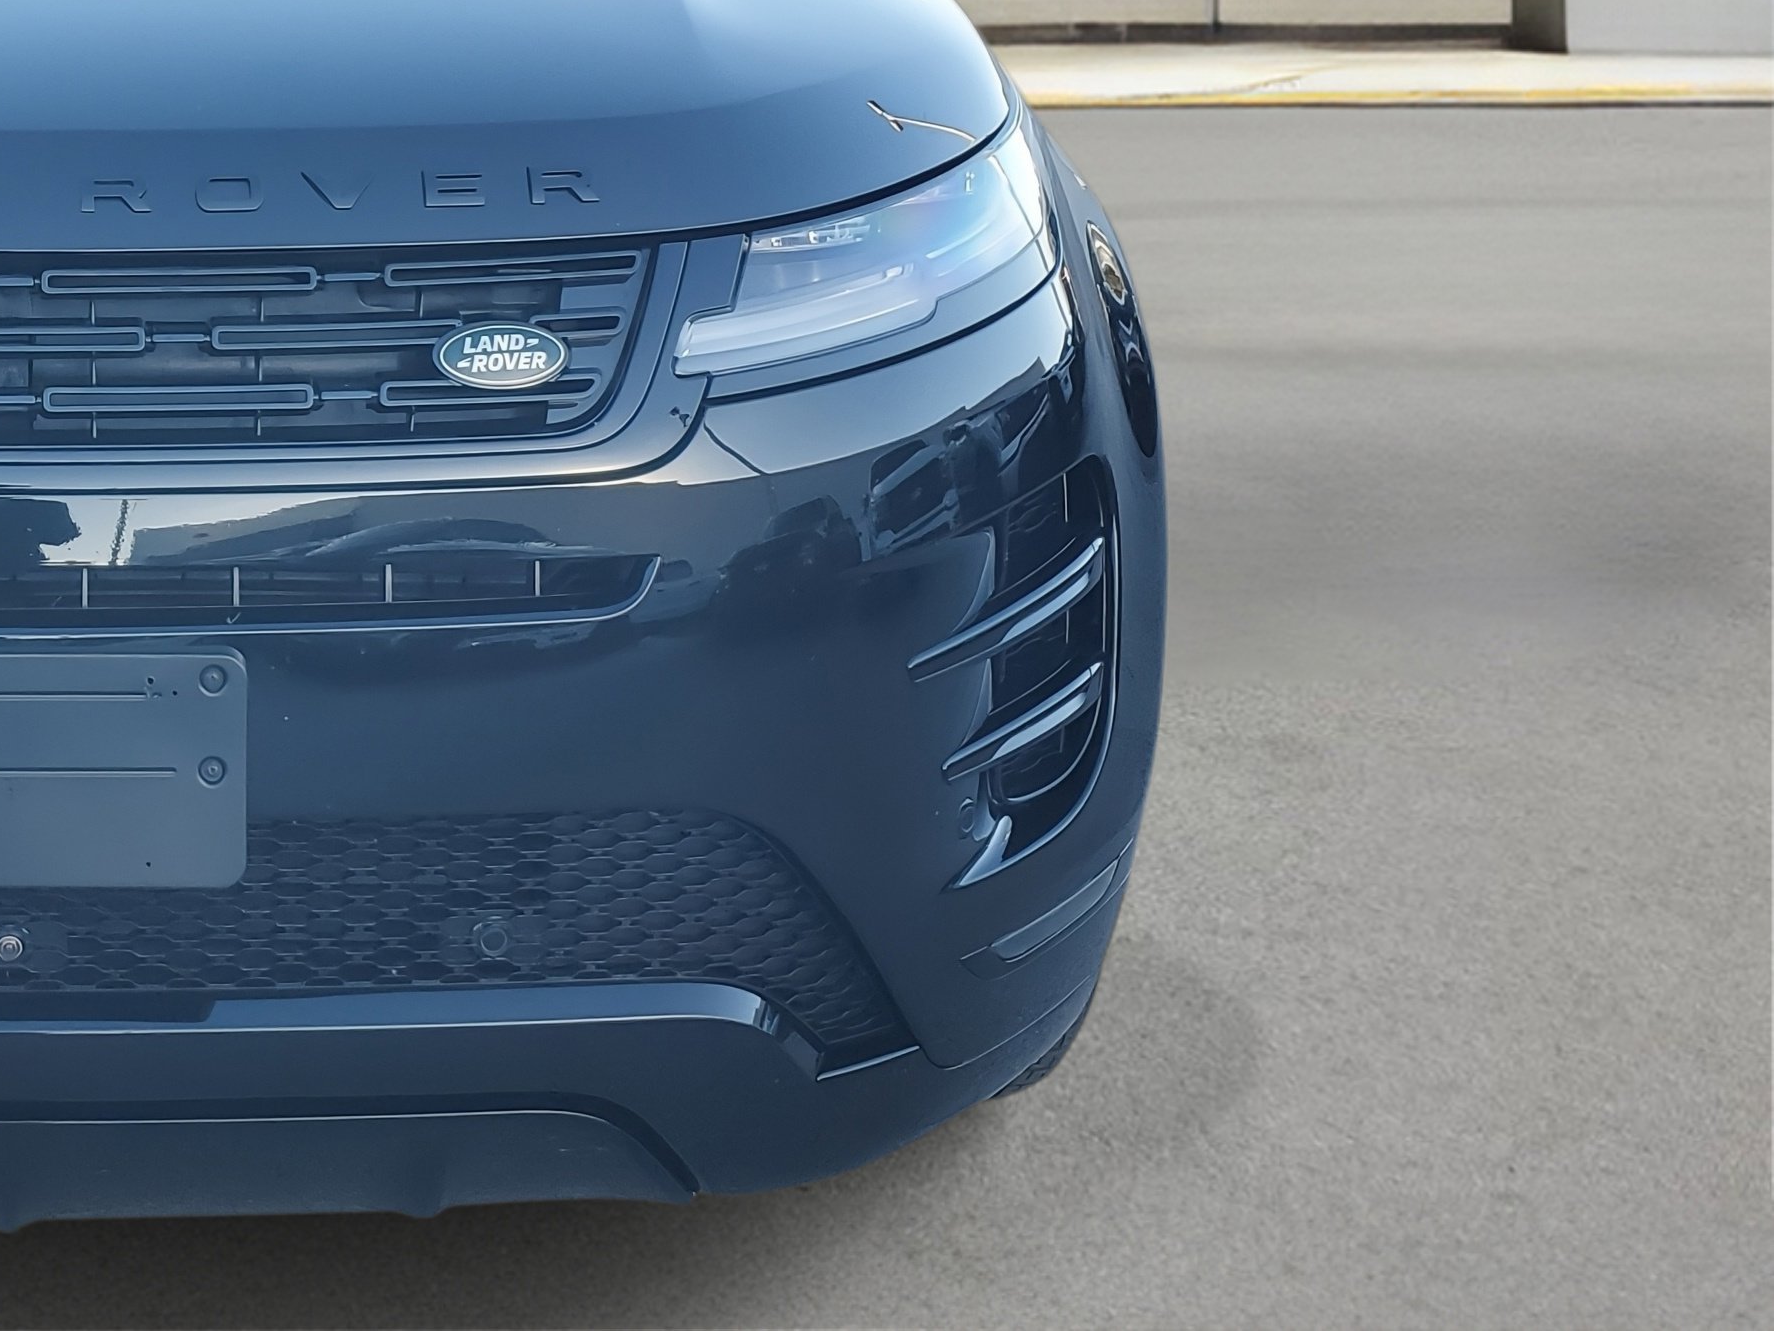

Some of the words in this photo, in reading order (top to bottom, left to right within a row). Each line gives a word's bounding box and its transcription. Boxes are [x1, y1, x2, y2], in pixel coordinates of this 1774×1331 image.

[80, 166, 601, 216] ROVER
[462, 333, 526, 354] LAND
[470, 351, 548, 374] ROVER
